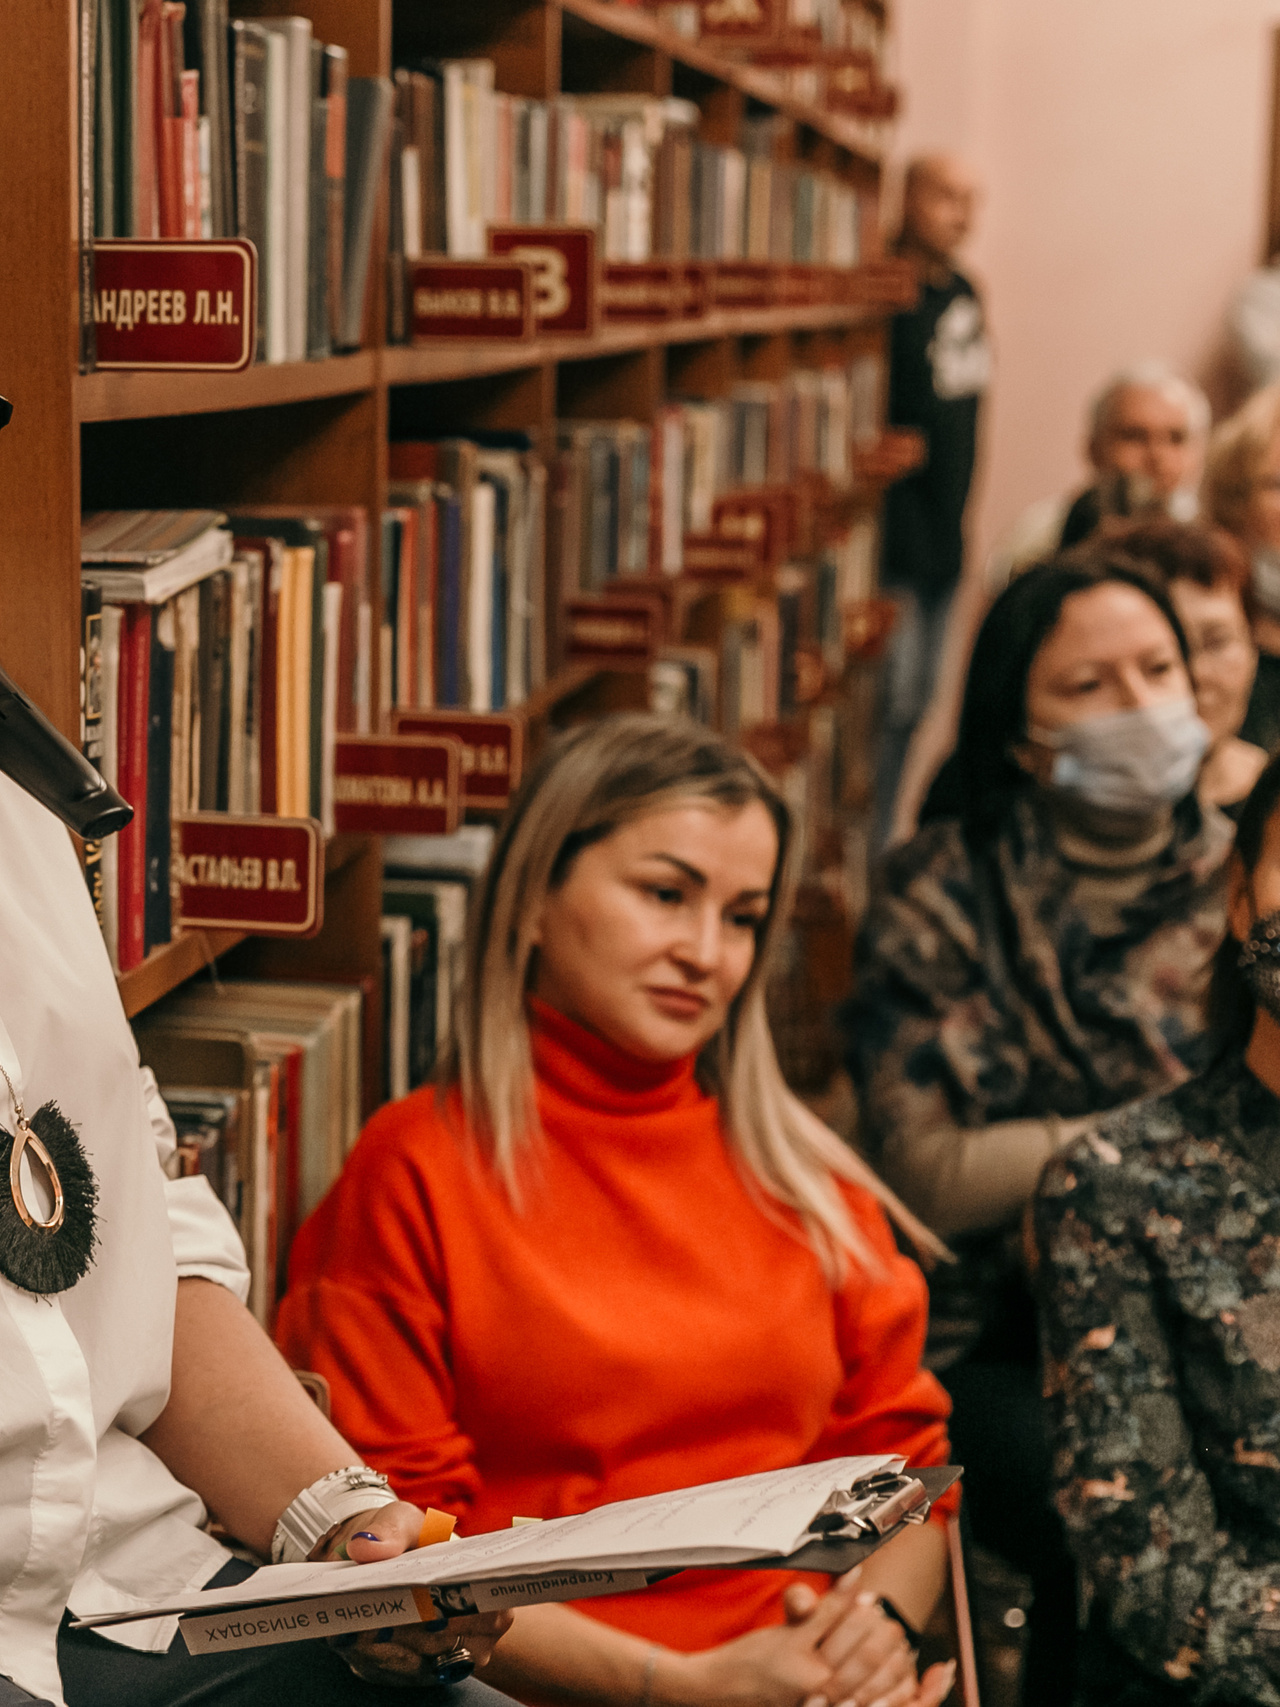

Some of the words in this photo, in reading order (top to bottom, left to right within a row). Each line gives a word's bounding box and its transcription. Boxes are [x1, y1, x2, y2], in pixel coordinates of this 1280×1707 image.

[193, 290, 240, 325] Л.Н.
[316, 1611, 329, 1624] В
[335, 1599, 407, 1621] ЖИЗНЬ
[205, 1613, 310, 1642] ЭПИЗОДАХ
